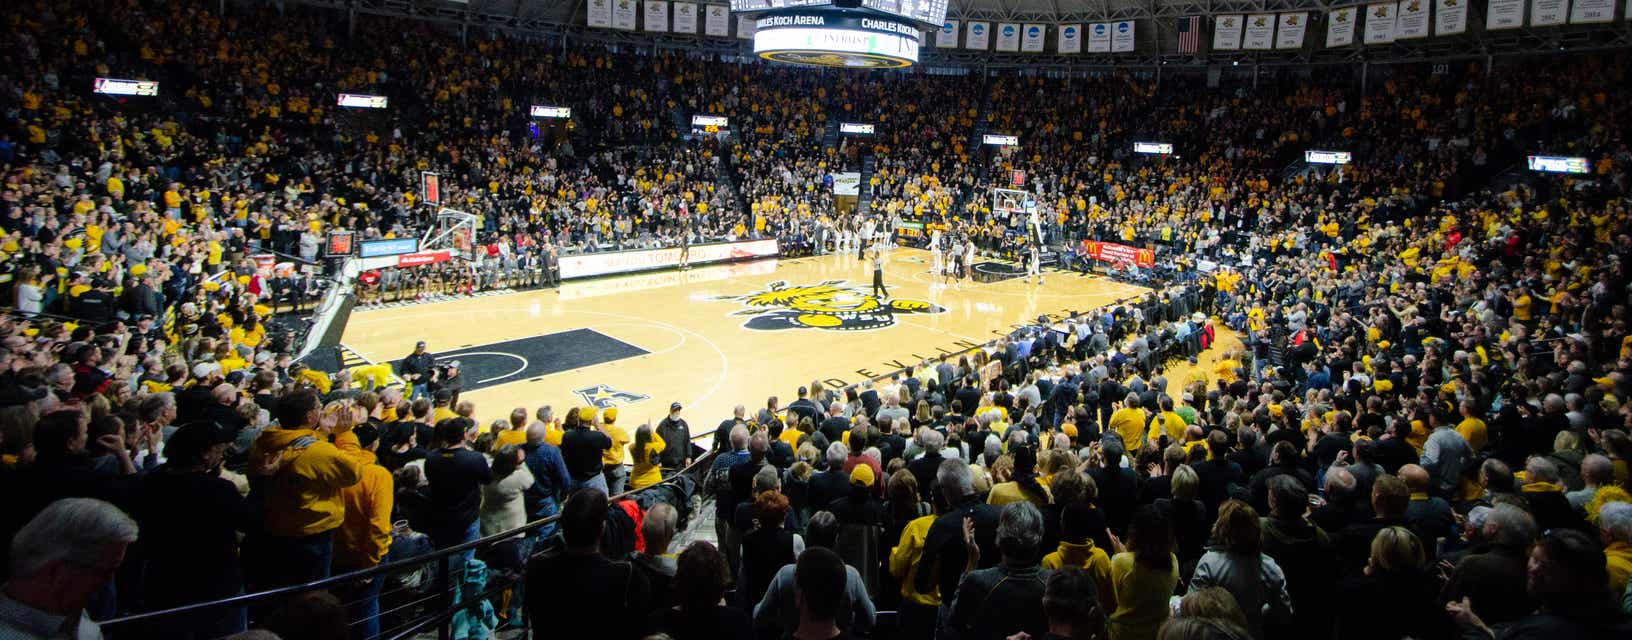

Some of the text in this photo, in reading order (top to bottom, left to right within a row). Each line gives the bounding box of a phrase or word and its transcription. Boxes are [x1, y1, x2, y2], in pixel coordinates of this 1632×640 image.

[773, 16, 793, 26] KOCH
[794, 15, 825, 25] ARENA
[861, 18, 897, 32] CHARLES
[897, 23, 912, 35] KOCH
[1432, 64, 1449, 74] 101
[839, 312, 890, 321] WSU
